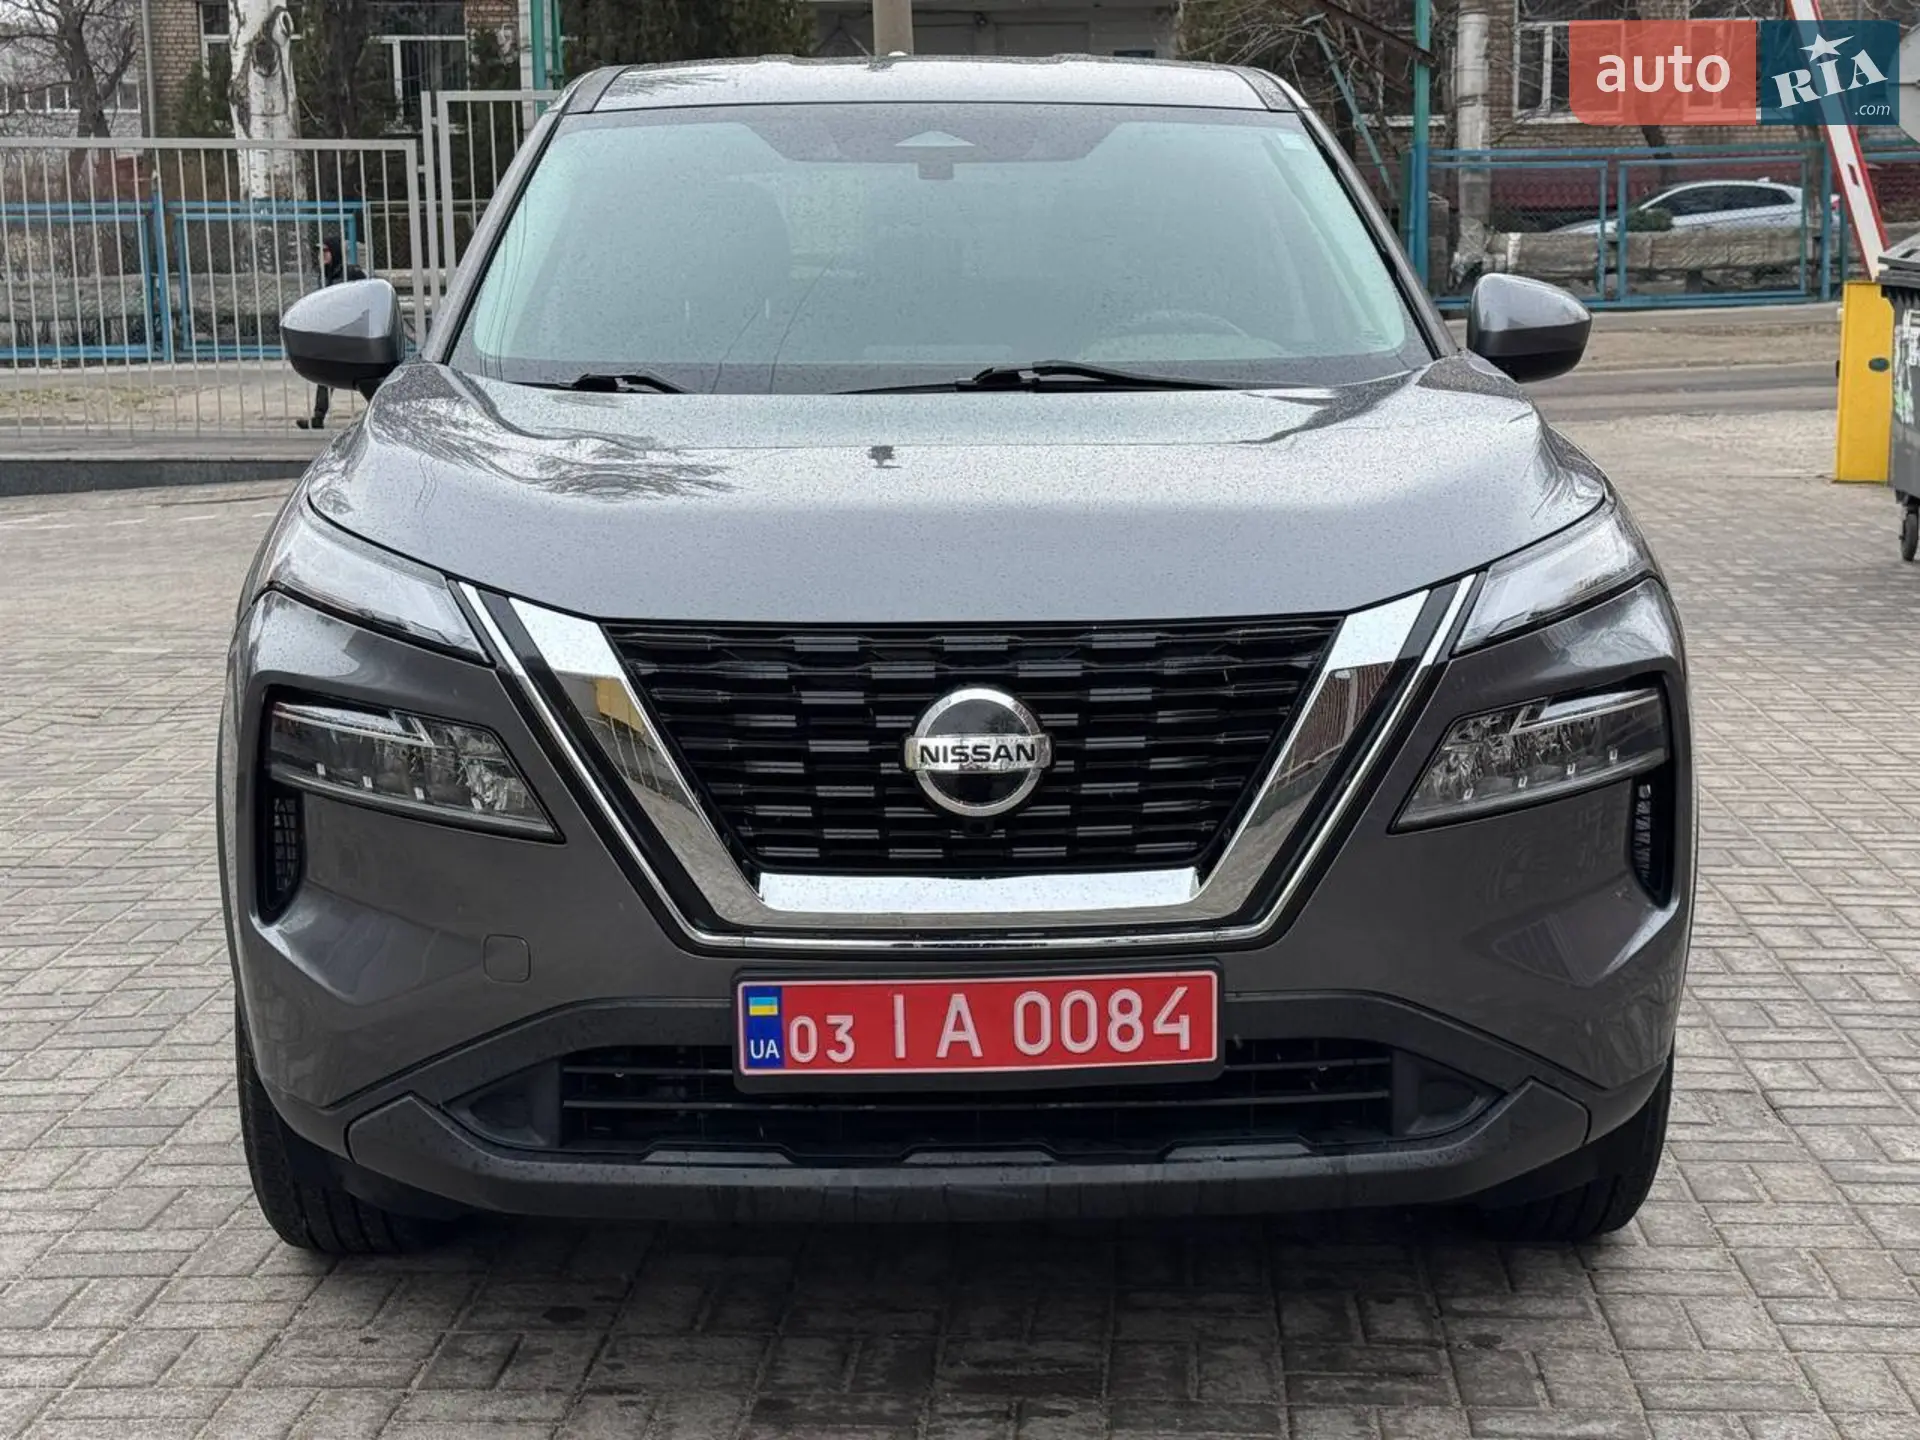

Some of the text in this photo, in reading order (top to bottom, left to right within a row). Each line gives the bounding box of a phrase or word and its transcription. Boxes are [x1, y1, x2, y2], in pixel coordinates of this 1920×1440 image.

[920, 743, 1035, 763] NISSAN
[788, 1014, 855, 1064] 03
[1013, 986, 1191, 1055] 0084
[750, 1039, 780, 1059] UA
